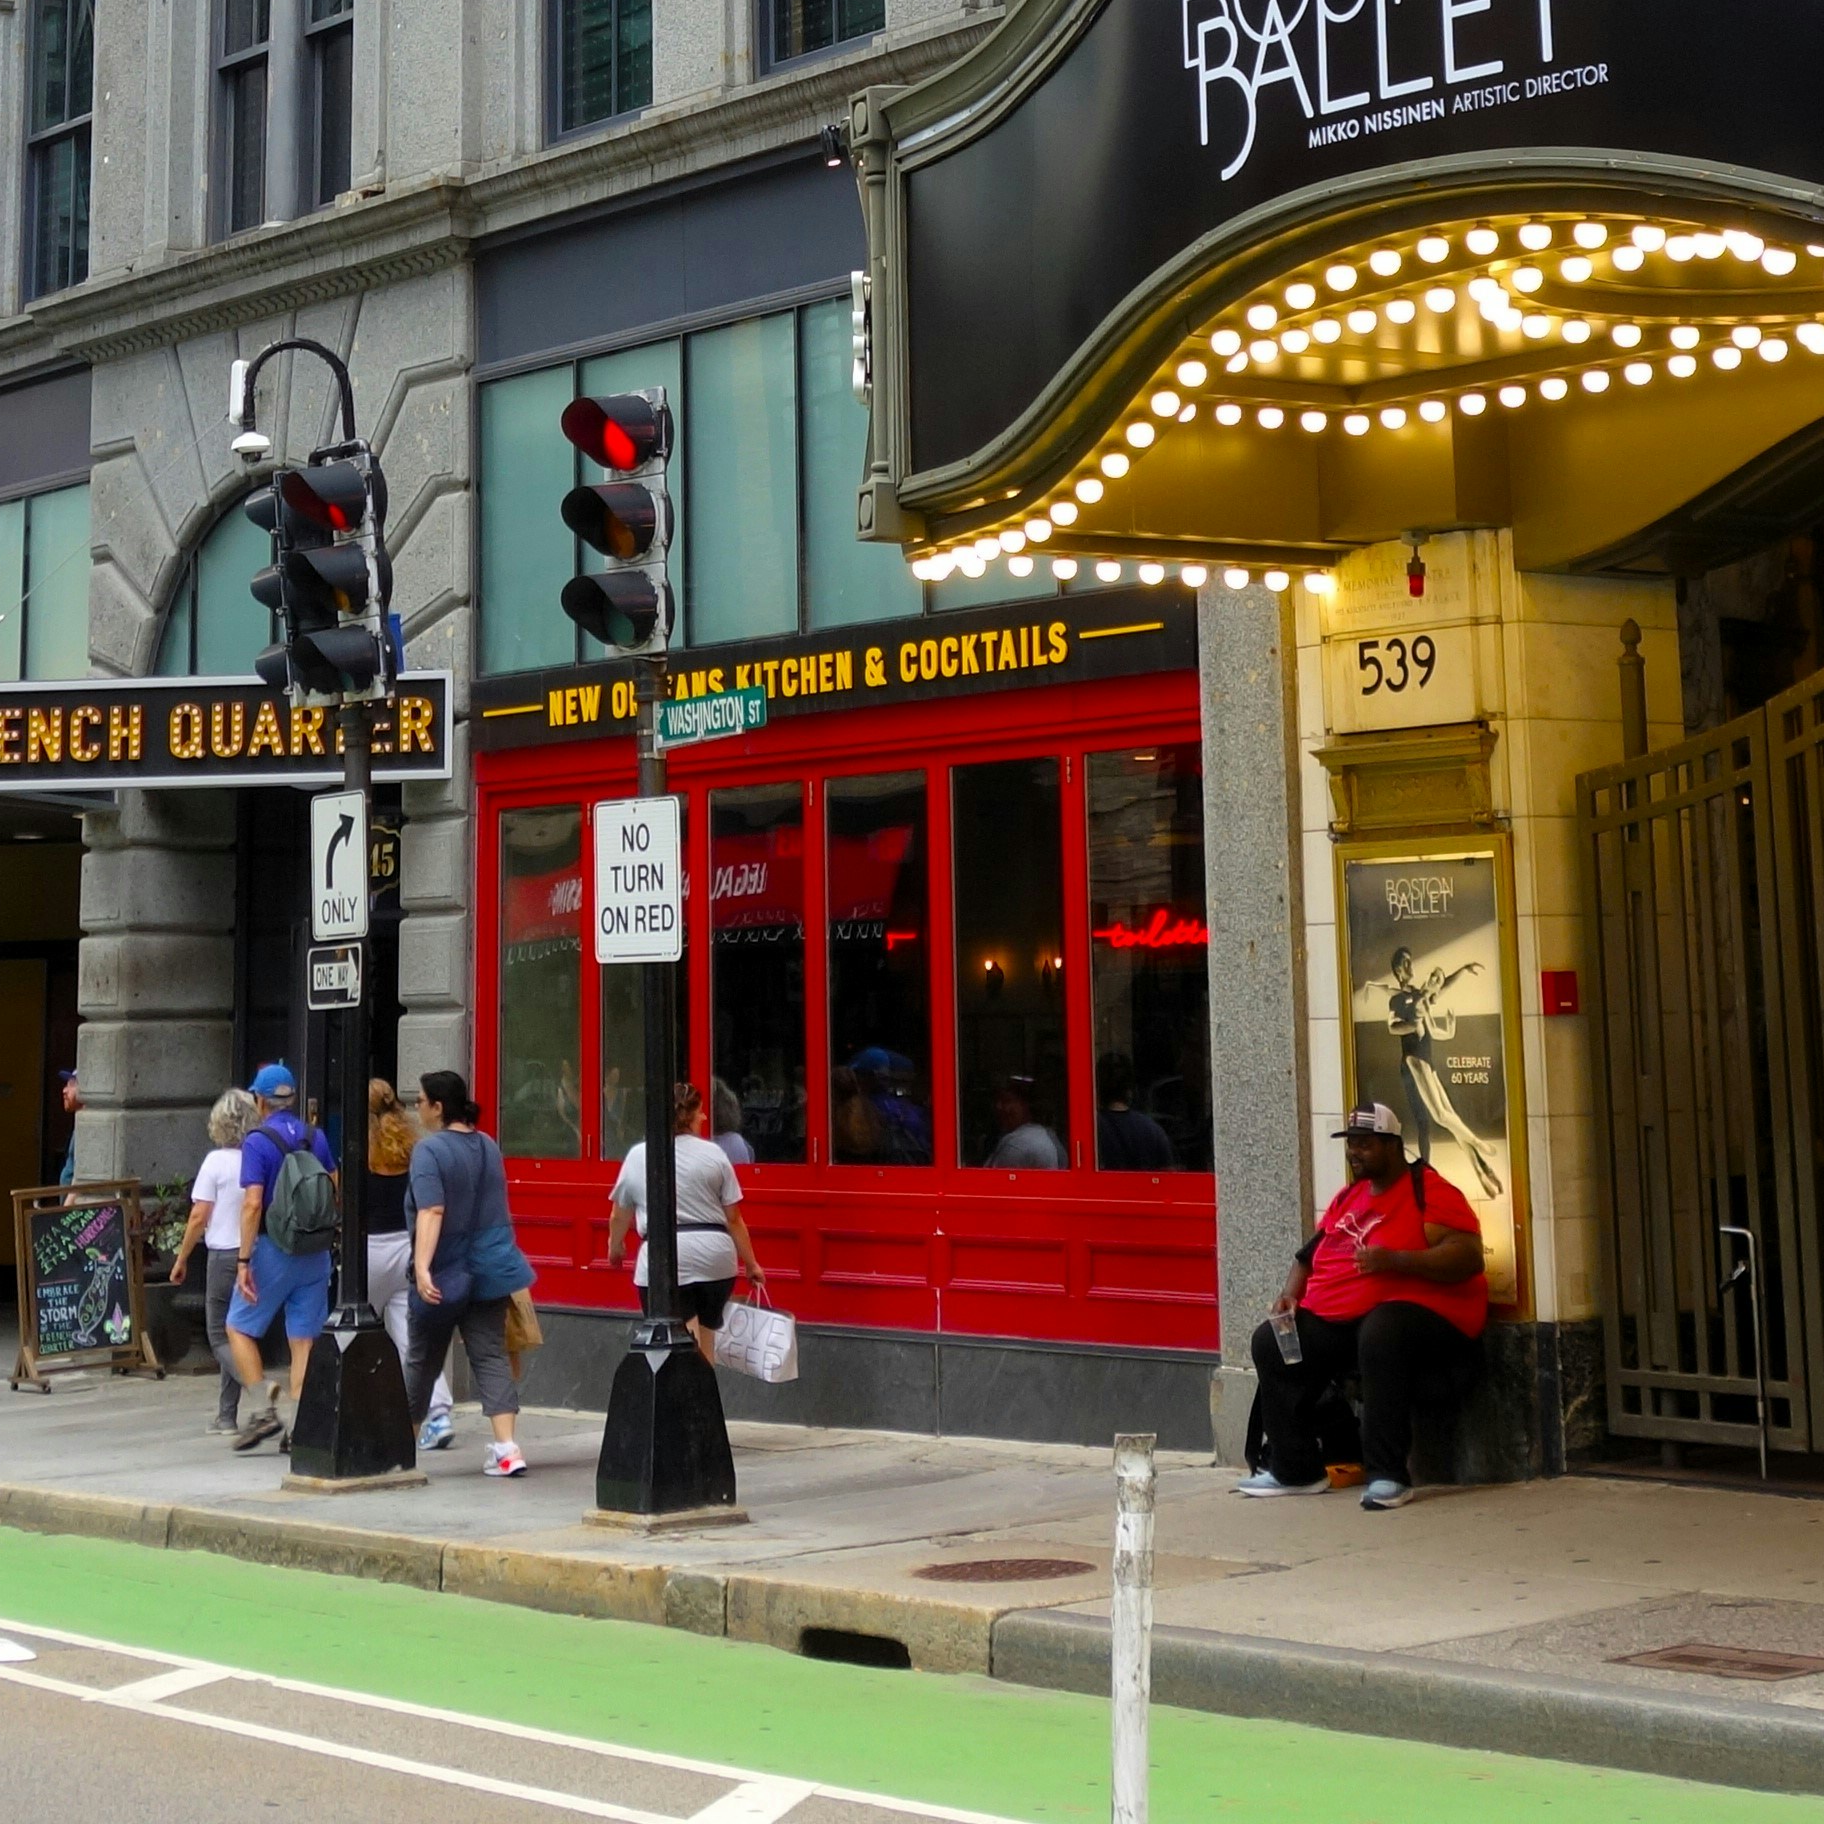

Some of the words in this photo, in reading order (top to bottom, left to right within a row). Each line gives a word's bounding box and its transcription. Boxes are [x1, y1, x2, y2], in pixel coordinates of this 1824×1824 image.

[1308, 118, 1359, 149] MIKKO
[1365, 98, 1446, 135] NISSINEN
[1452, 81, 1520, 115] ARTISTIC
[1525, 63, 1609, 99] DIRECTOR
[549, 685, 601, 727] NEW
[612, 669, 724, 720] OANS
[736, 650, 853, 700] KITCHEN
[865, 647, 887, 687] &
[900, 622, 1068, 683] COCKTAILS
[1358, 635, 1436, 696] 539
[169, 696, 435, 759] QUARER
[667, 695, 744, 736] WASHINGTON
[748, 699, 761, 724] ST
[622, 824, 651, 853] NO
[610, 863, 664, 894] TURN
[1385, 877, 1454, 901] BOSTON
[321, 896, 358, 925] ONLY
[601, 906, 629, 935] ON
[635, 904, 675, 934] RED
[1389, 890, 1449, 921] BALLET
[315, 966, 334, 988] ONE
[337, 965, 349, 987] WAY
[1446, 1056, 1491, 1069] CELEBRATE
[1451, 1072, 1462, 1084] 60
[1463, 1072, 1489, 1084] YEARS
[37, 1283, 80, 1298] EMBRACE
[48, 1296, 68, 1307] THE
[40, 1306, 78, 1324] STORM
[39, 1340, 75, 1356] QUARTER
